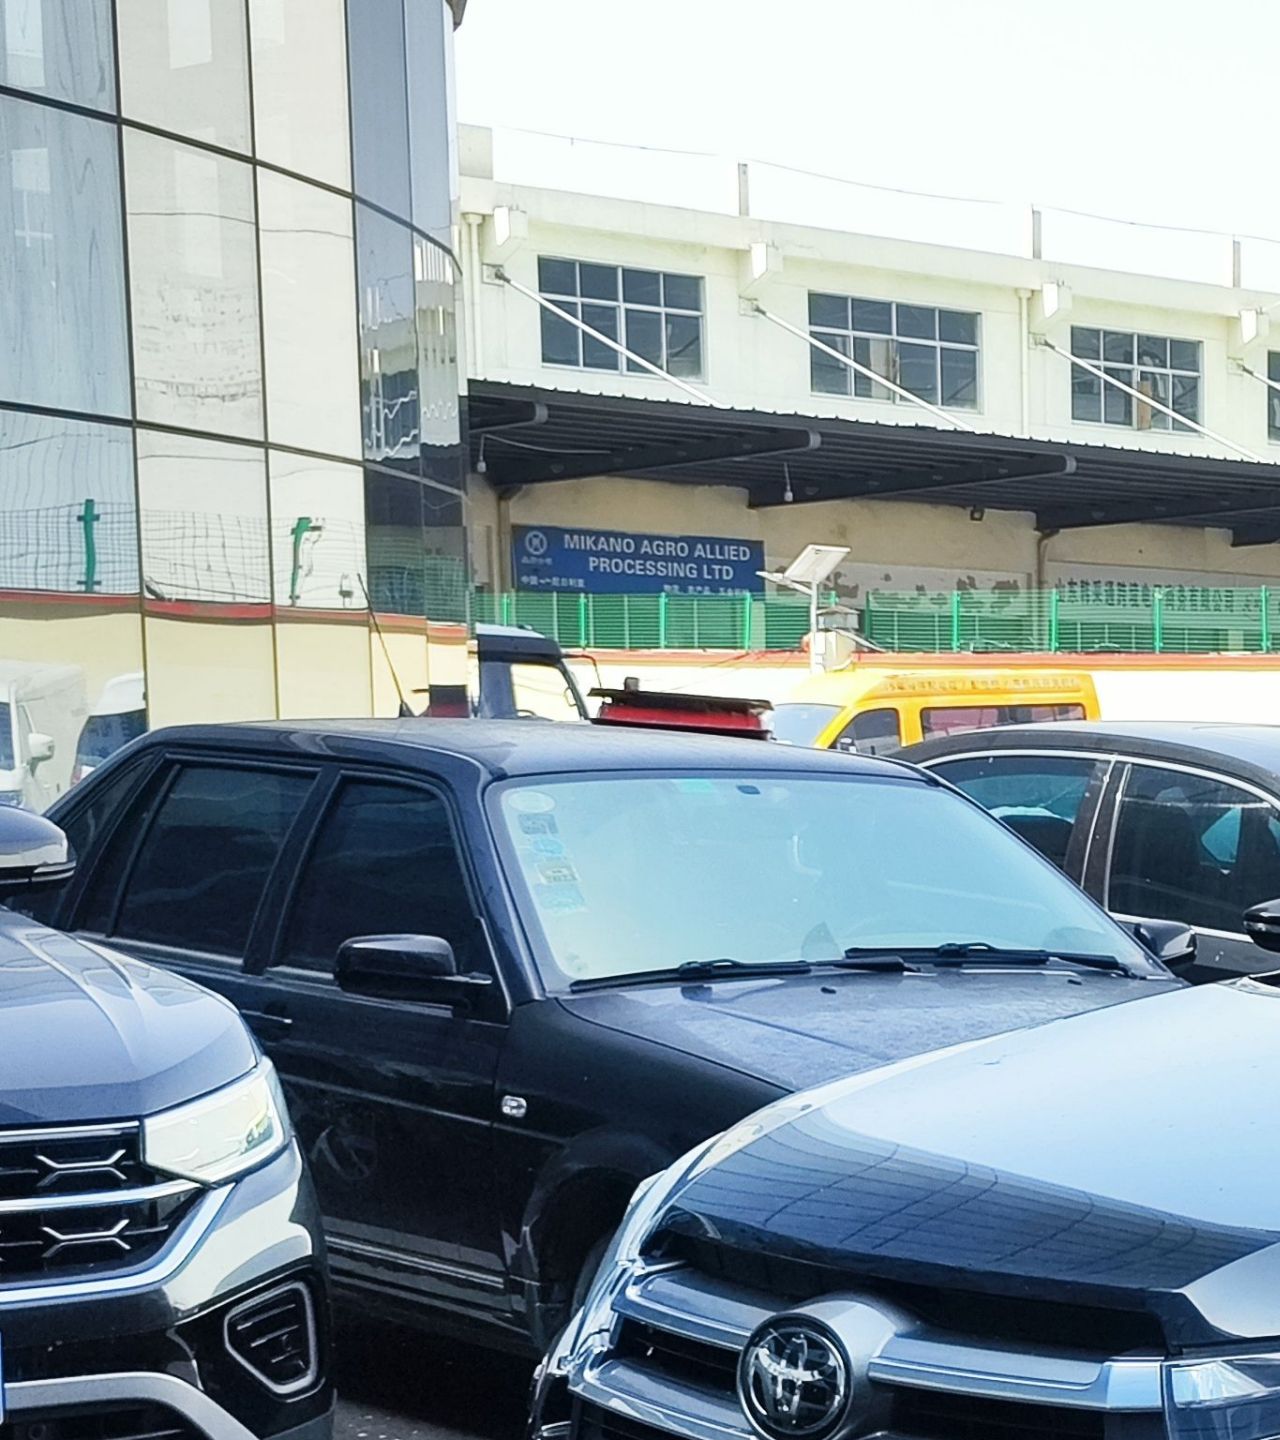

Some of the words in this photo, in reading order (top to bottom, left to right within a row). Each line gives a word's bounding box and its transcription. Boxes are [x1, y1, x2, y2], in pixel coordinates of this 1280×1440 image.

[564, 534, 635, 554] MIKANO
[640, 540, 689, 558] AGRO
[694, 544, 750, 561] ALLIED
[589, 557, 697, 578] PROCESSING
[703, 565, 734, 581] LTD
